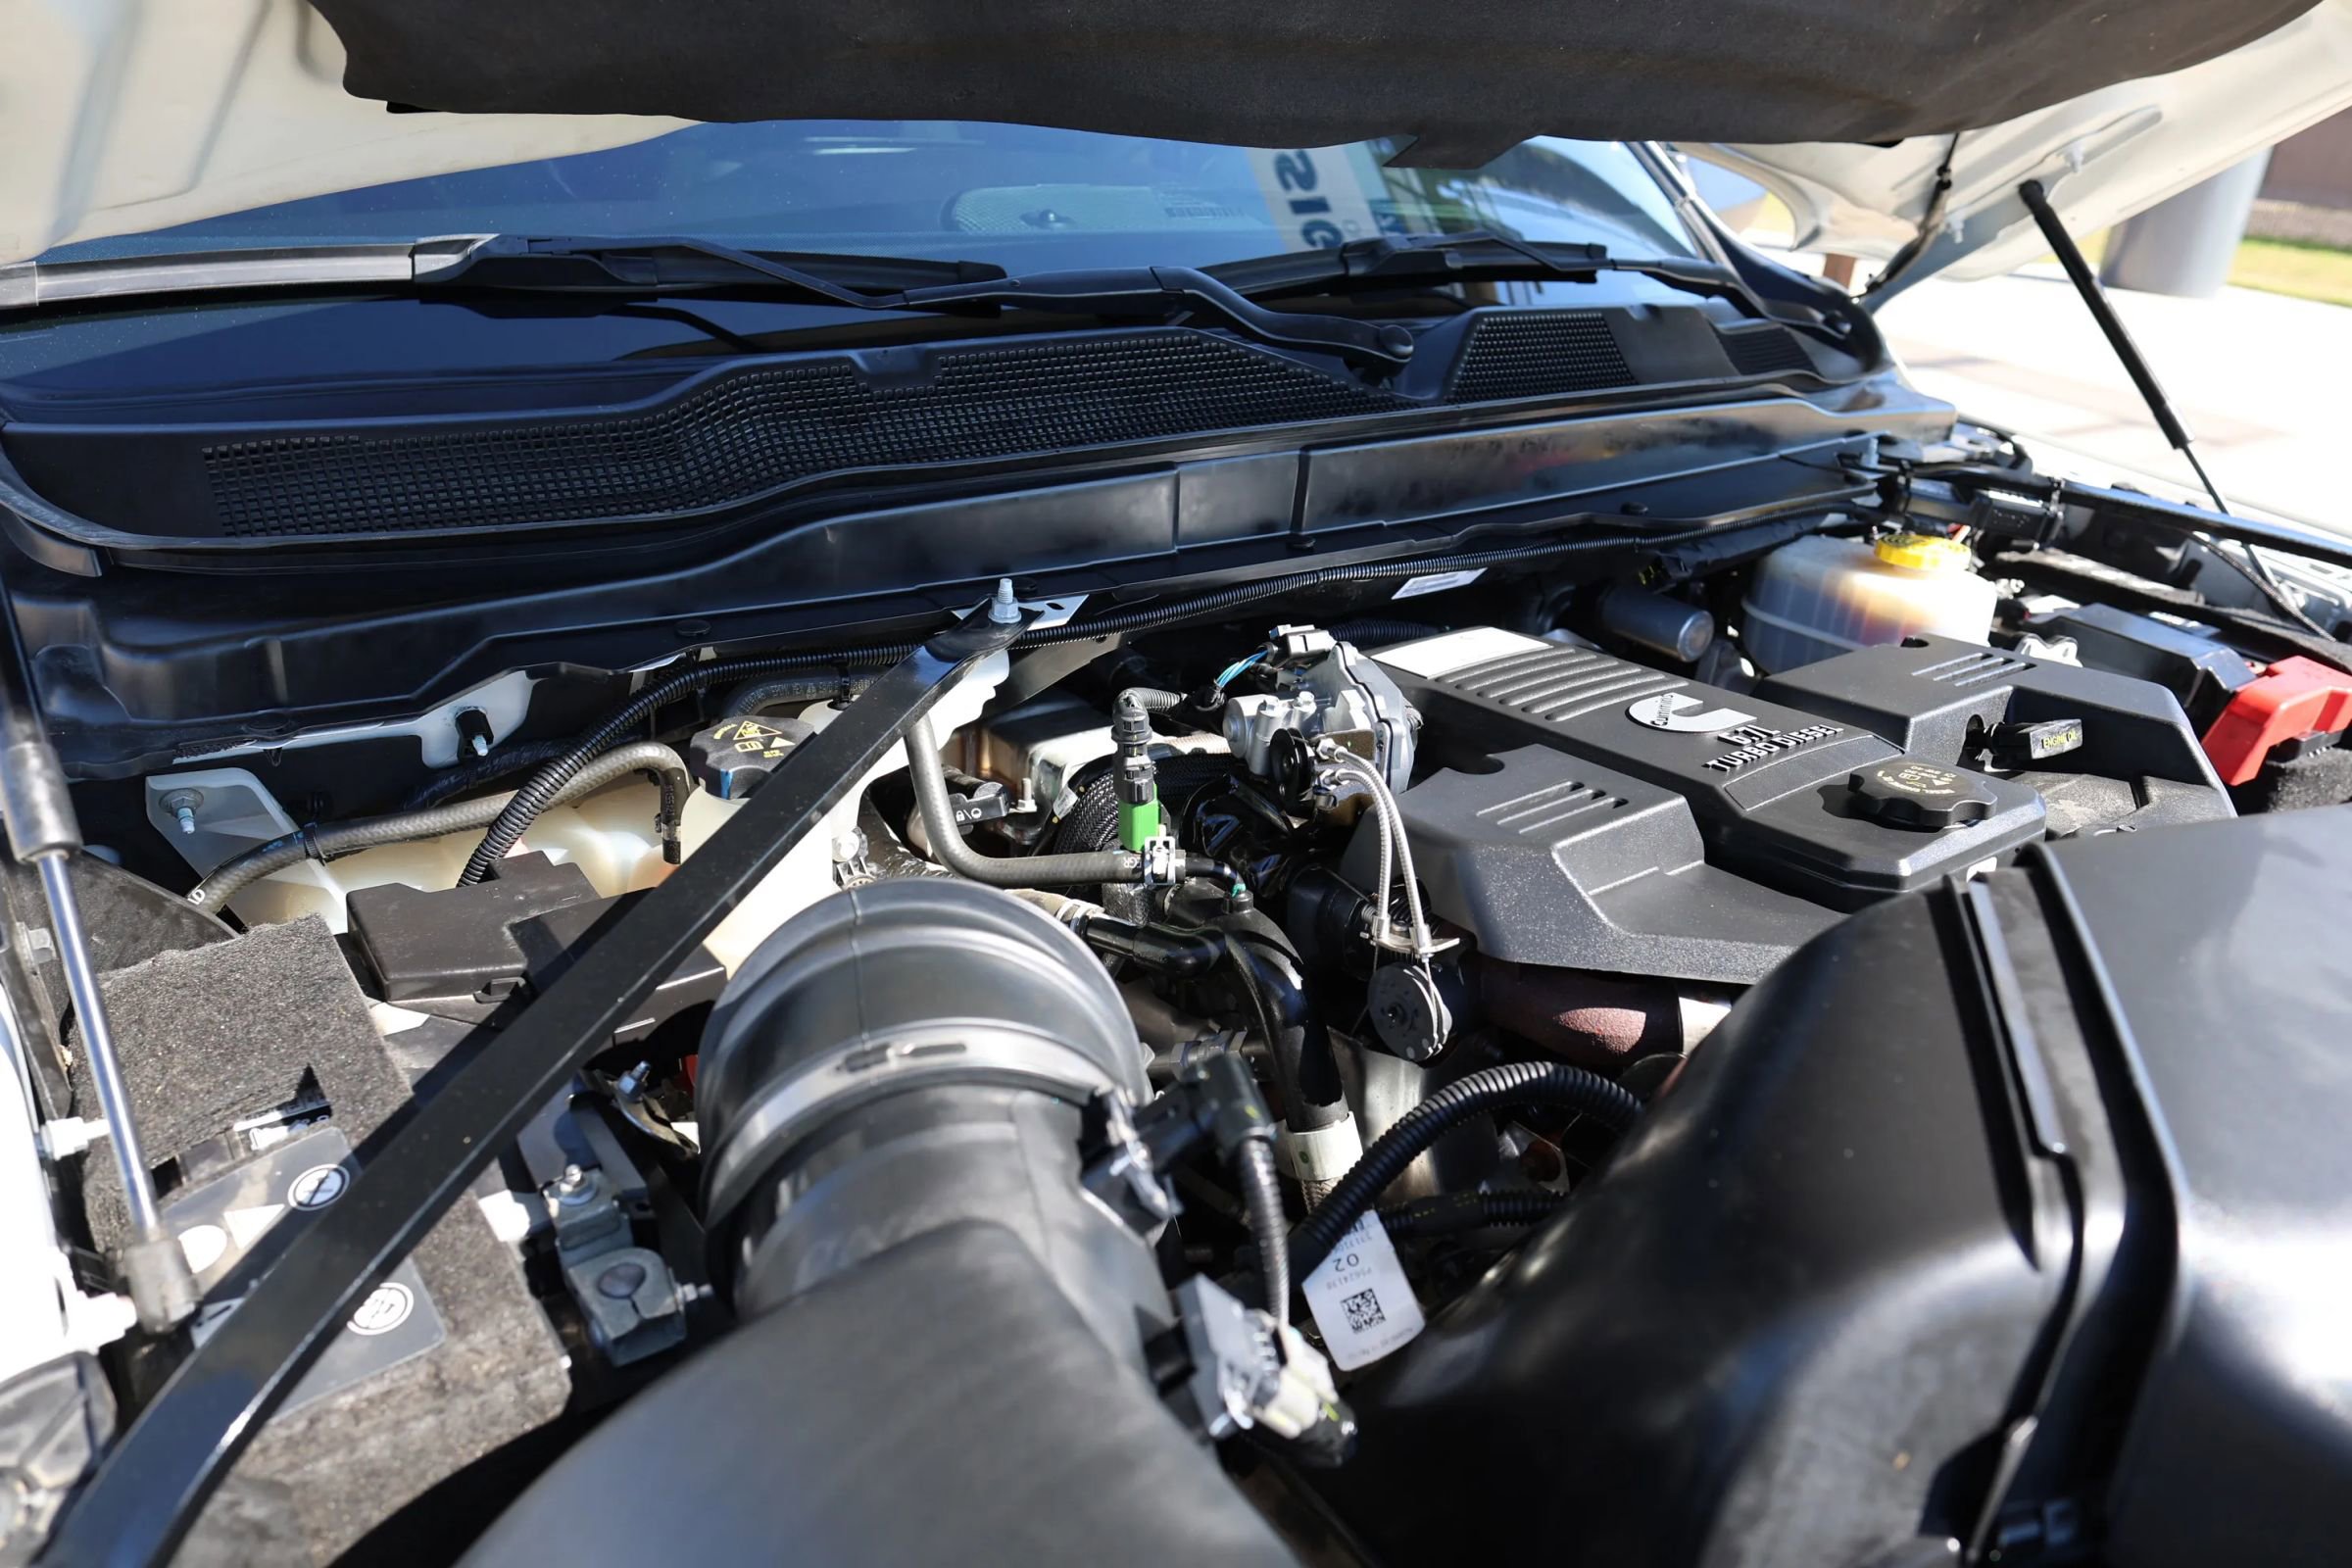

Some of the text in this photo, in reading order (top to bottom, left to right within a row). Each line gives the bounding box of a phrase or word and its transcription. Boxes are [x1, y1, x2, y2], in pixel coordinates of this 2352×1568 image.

[1703, 724, 1844, 772] TURBO DIESEL
[1717, 724, 1781, 746] 6.7L
